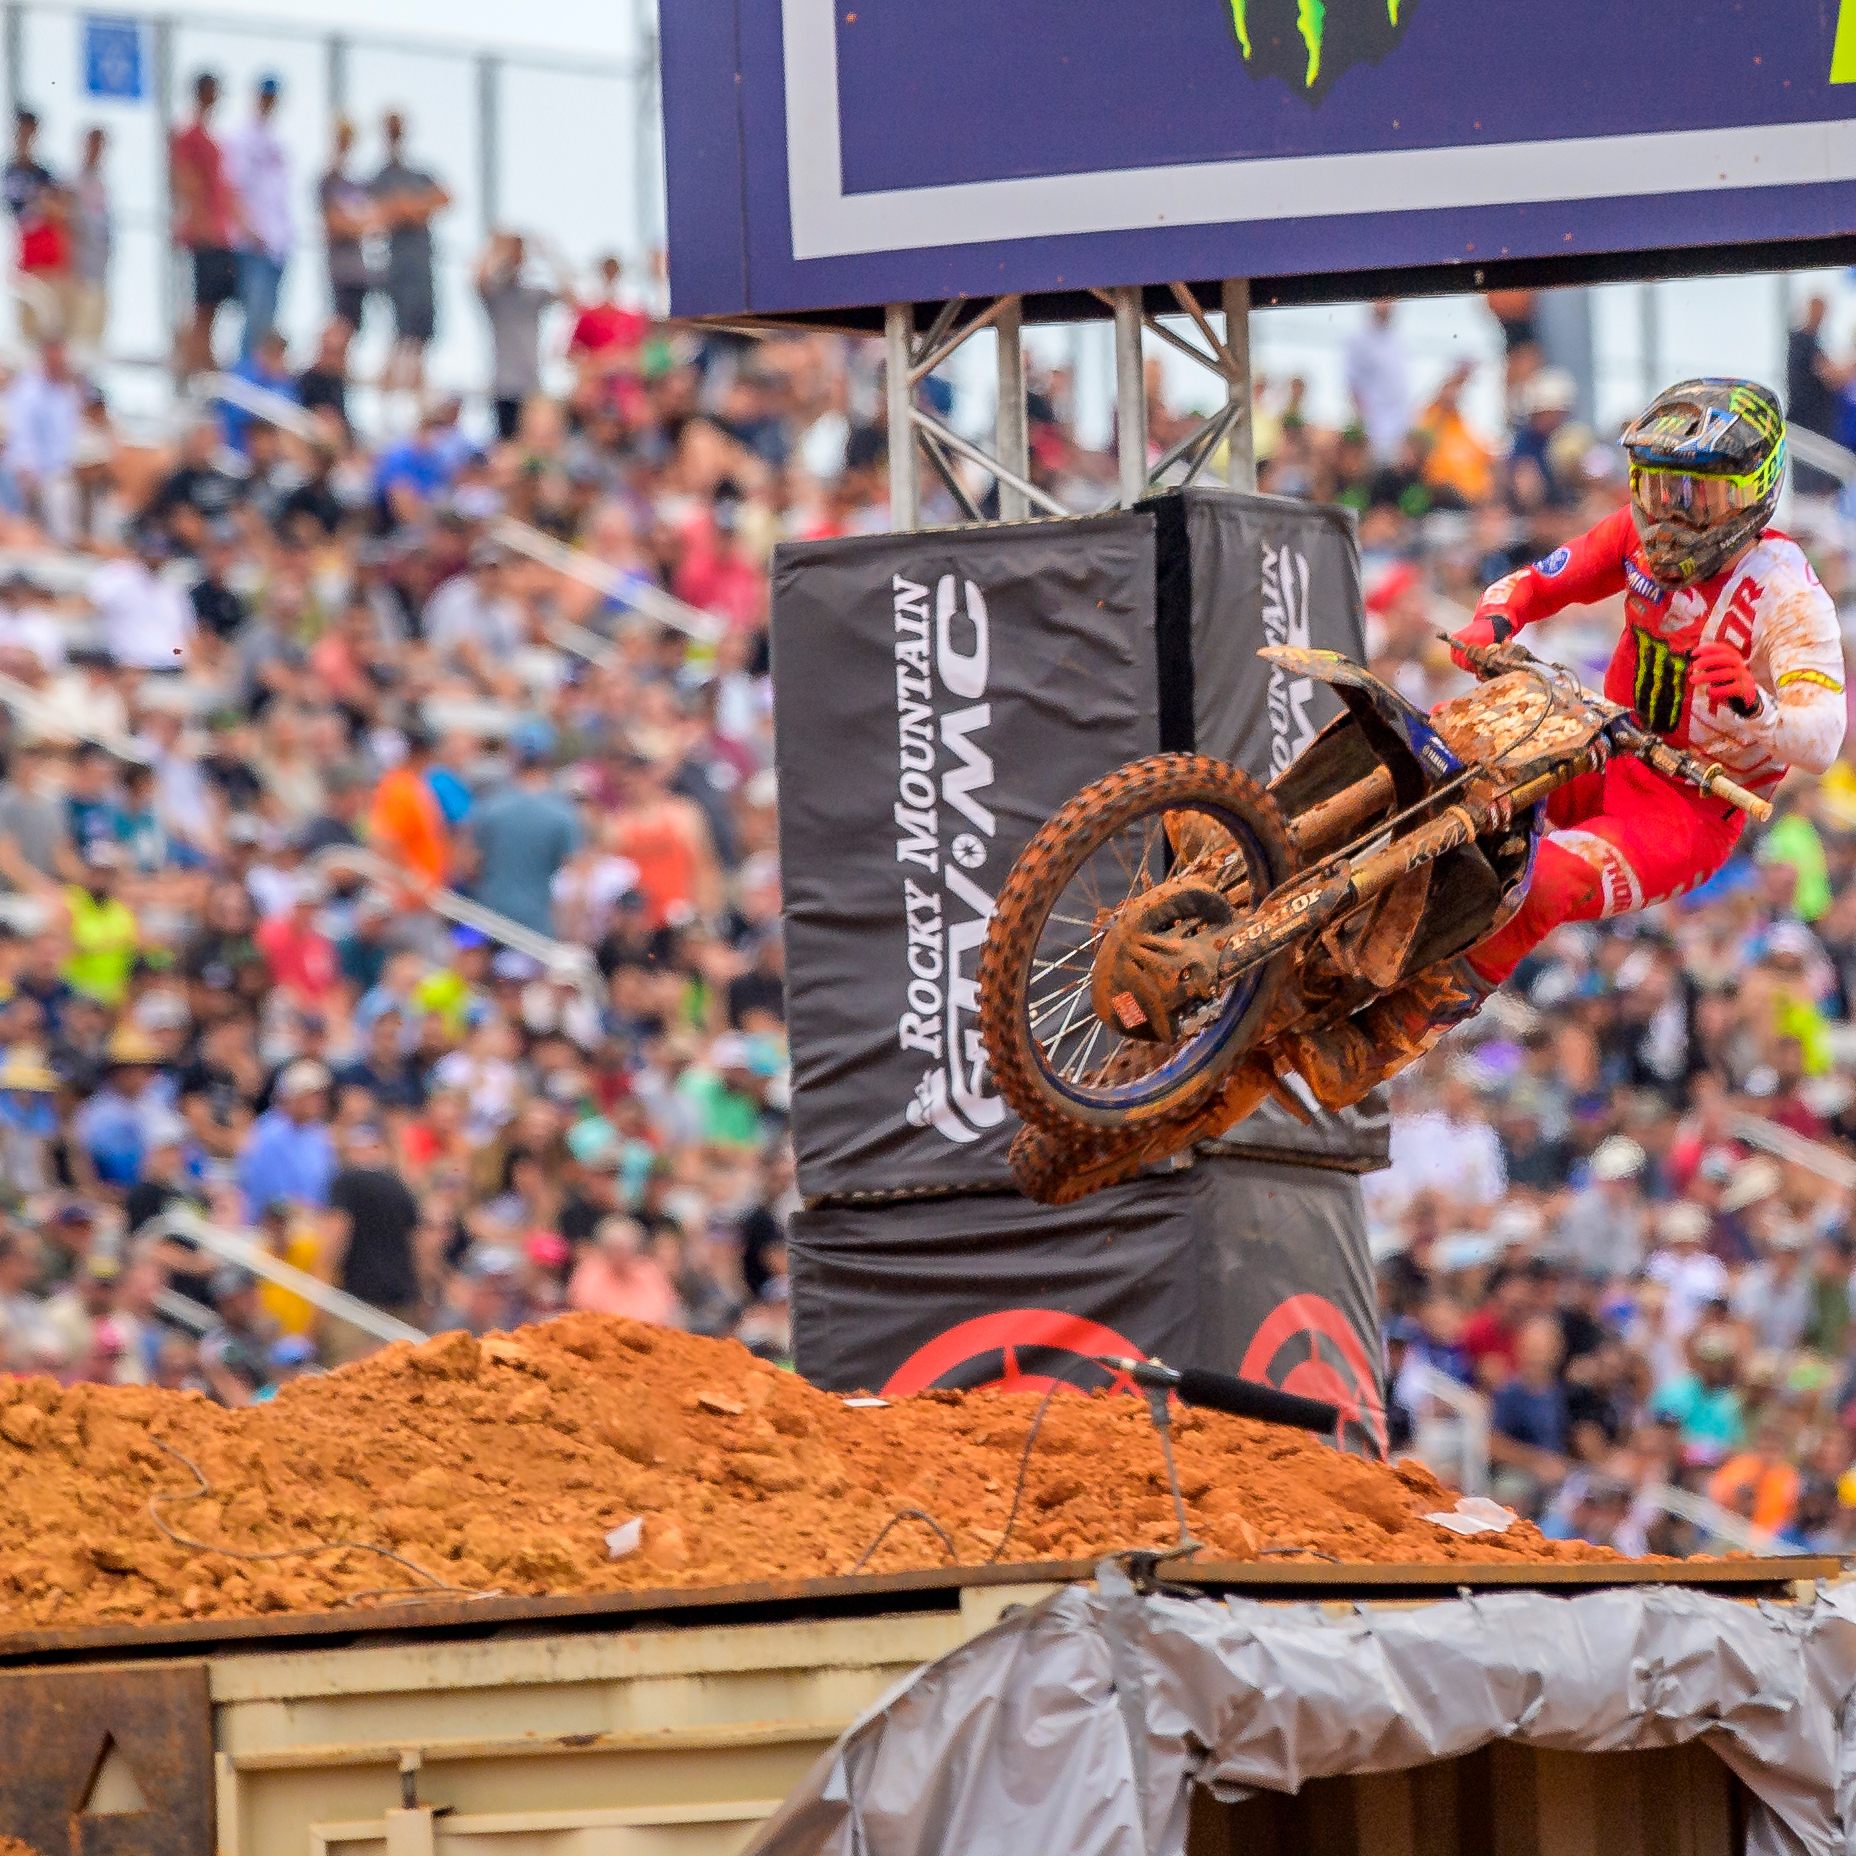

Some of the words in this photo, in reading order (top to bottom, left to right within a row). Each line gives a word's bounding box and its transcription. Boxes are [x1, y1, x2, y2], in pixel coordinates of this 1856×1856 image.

[893, 575, 941, 875] MOUNTAIN
[1260, 541, 1292, 784] OUNTAIN
[898, 878, 943, 1059] ROCKY
